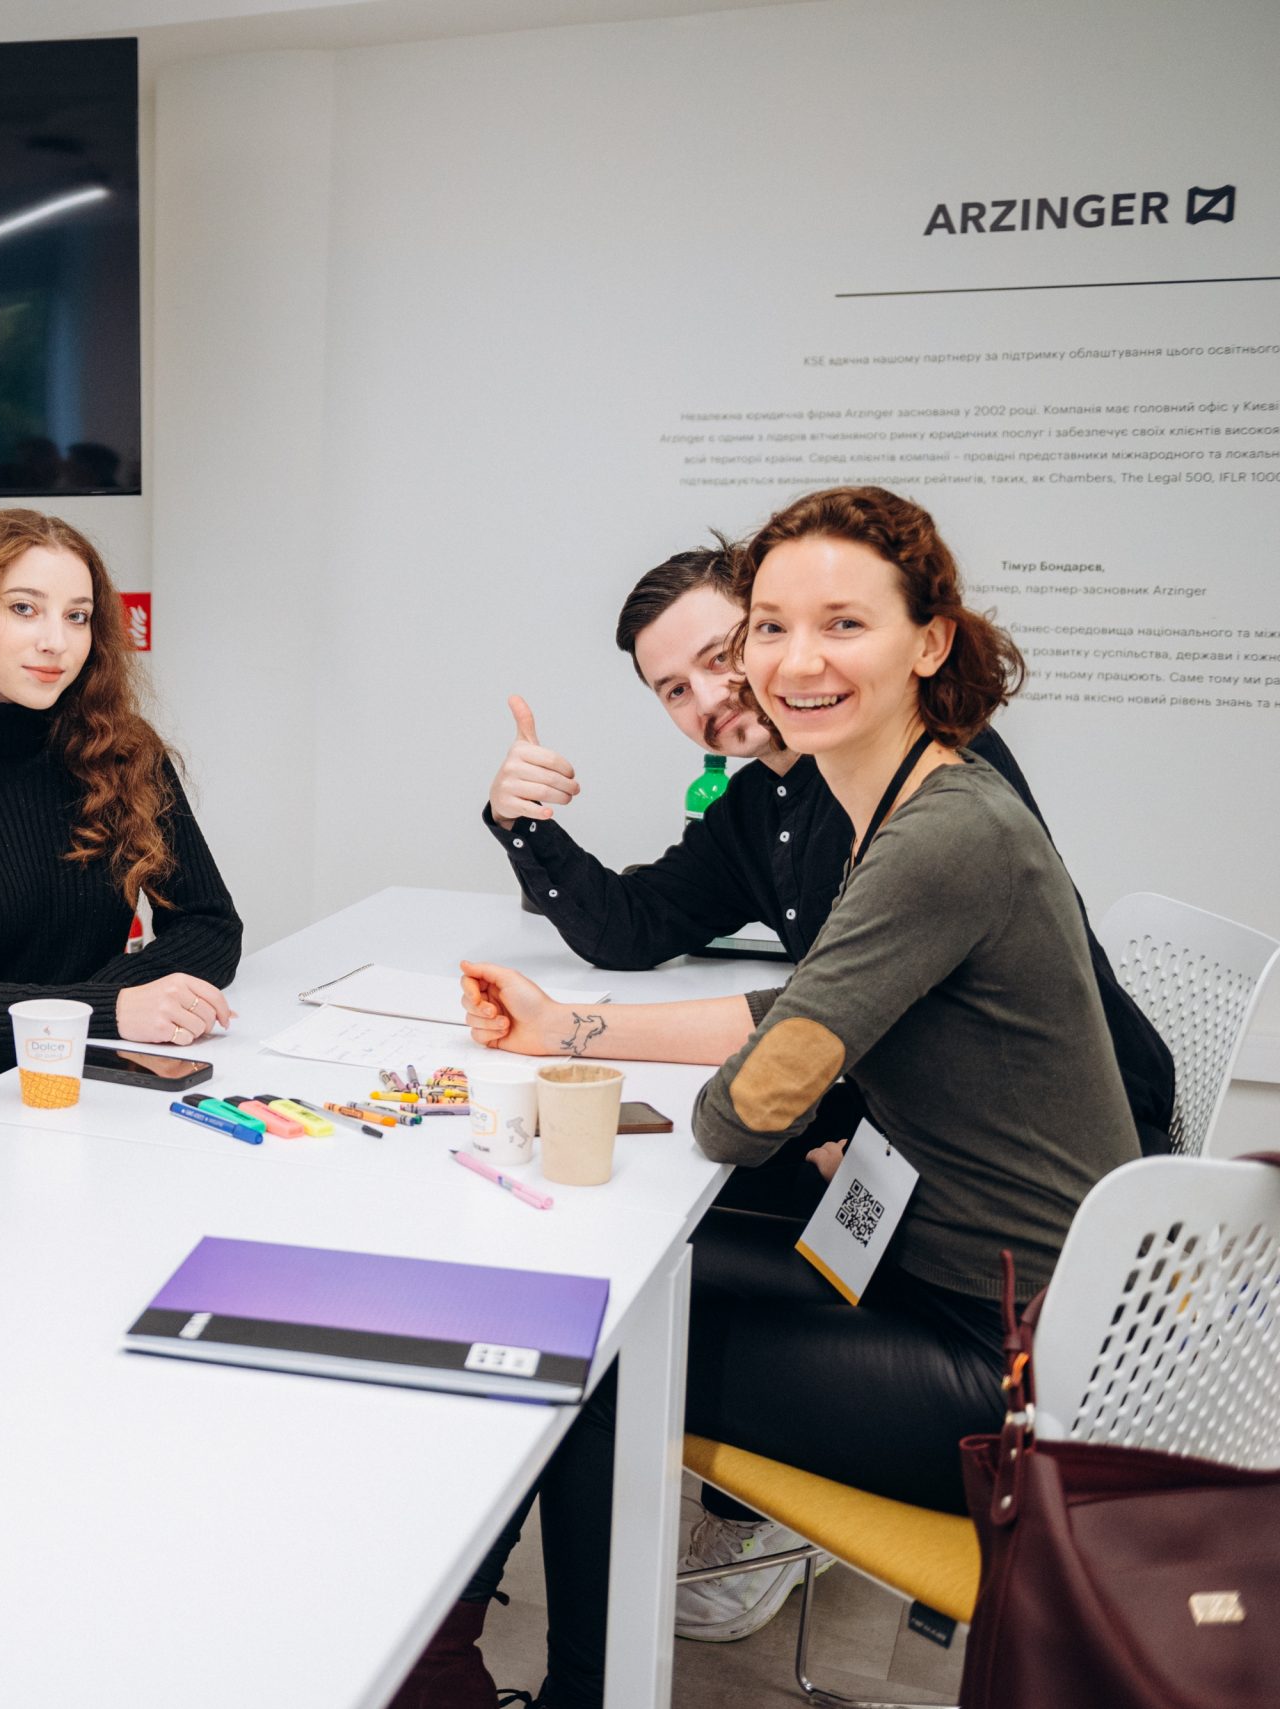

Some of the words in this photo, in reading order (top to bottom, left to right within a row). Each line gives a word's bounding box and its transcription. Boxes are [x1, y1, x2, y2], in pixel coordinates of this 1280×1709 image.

[923, 191, 1169, 236] ARZINGER
[803, 356, 825, 367] KSE
[828, 355, 870, 367] вдячна
[873, 354, 920, 366] нашому
[923, 352, 981, 364] партнеру
[984, 352, 998, 361] за
[1001, 350, 1065, 362] підтримку
[1069, 347, 1162, 360] облаштування
[1166, 346, 1203, 358] цього
[1207, 344, 1280, 356] освітнього
[680, 412, 743, 421] Незалежна
[746, 411, 804, 422] юридична
[807, 409, 842, 421] фірма
[844, 407, 893, 420] Arzinger
[897, 408, 960, 418] заснована
[963, 408, 970, 419] у
[974, 405, 1006, 416] 2002
[1009, 405, 1039, 417] році.
[1043, 403, 1102, 415] Компанія
[1105, 403, 1129, 414] має
[1134, 402, 1195, 413] головний
[1198, 401, 1228, 414] офіс
[1232, 403, 1239, 414] у
[1242, 400, 1279, 412] Києві
[659, 433, 705, 444] Arzinger
[810, 431, 887, 441] вітчизняного
[890, 431, 925, 442] ринку
[929, 429, 998, 440] юридичних
[1002, 429, 1044, 440] послуг
[1055, 425, 1128, 438] забезпечує
[1132, 426, 1165, 437] своїх
[1169, 425, 1221, 436] клієнтів
[710, 453, 762, 465] території
[809, 452, 846, 464] Серед
[850, 452, 896, 463] клієнтів
[899, 451, 950, 462] компанії
[963, 451, 1015, 462] провідні
[1019, 450, 1108, 462] представники
[1111, 449, 1204, 461] міжнародного
[1208, 450, 1221, 460] та
[842, 475, 919, 485] міжнародних
[924, 473, 986, 485] рейтингів,
[990, 474, 1027, 485] таких,
[1031, 474, 1044, 483] як
[1049, 472, 1117, 484] Chambers,
[1121, 472, 1144, 483] The
[1147, 472, 1182, 485] Legal
[1185, 472, 1214, 484] 500,
[1219, 471, 1247, 483] IFLR
[1001, 560, 1036, 572] Тімур
[1039, 561, 1105, 573] Бондарєв,
[968, 583, 1022, 595] партнер,
[1025, 584, 1149, 596] партнер-засновник
[1153, 585, 1207, 597] Arzinger
[1010, 622, 1134, 636] бізнес-середовища
[1137, 627, 1233, 638] національного
[1237, 629, 1250, 638] та
[1033, 648, 1089, 658] розвитку
[1093, 647, 1172, 660] суспільства,
[1175, 650, 1233, 662] держави
[1046, 670, 1052, 679] у
[1055, 671, 1094, 681] ньому
[1097, 671, 1165, 682] працюють.
[1169, 672, 1204, 683] Саме
[1208, 675, 1240, 686] тому
[1243, 676, 1261, 684] ми
[1065, 693, 1080, 702] на
[1084, 693, 1124, 703] якісно
[1128, 694, 1167, 704] новий
[1170, 695, 1212, 707] рівень
[1215, 698, 1253, 708] знань
[1257, 699, 1270, 708] та
[31, 1041, 65, 1051] Dolce
